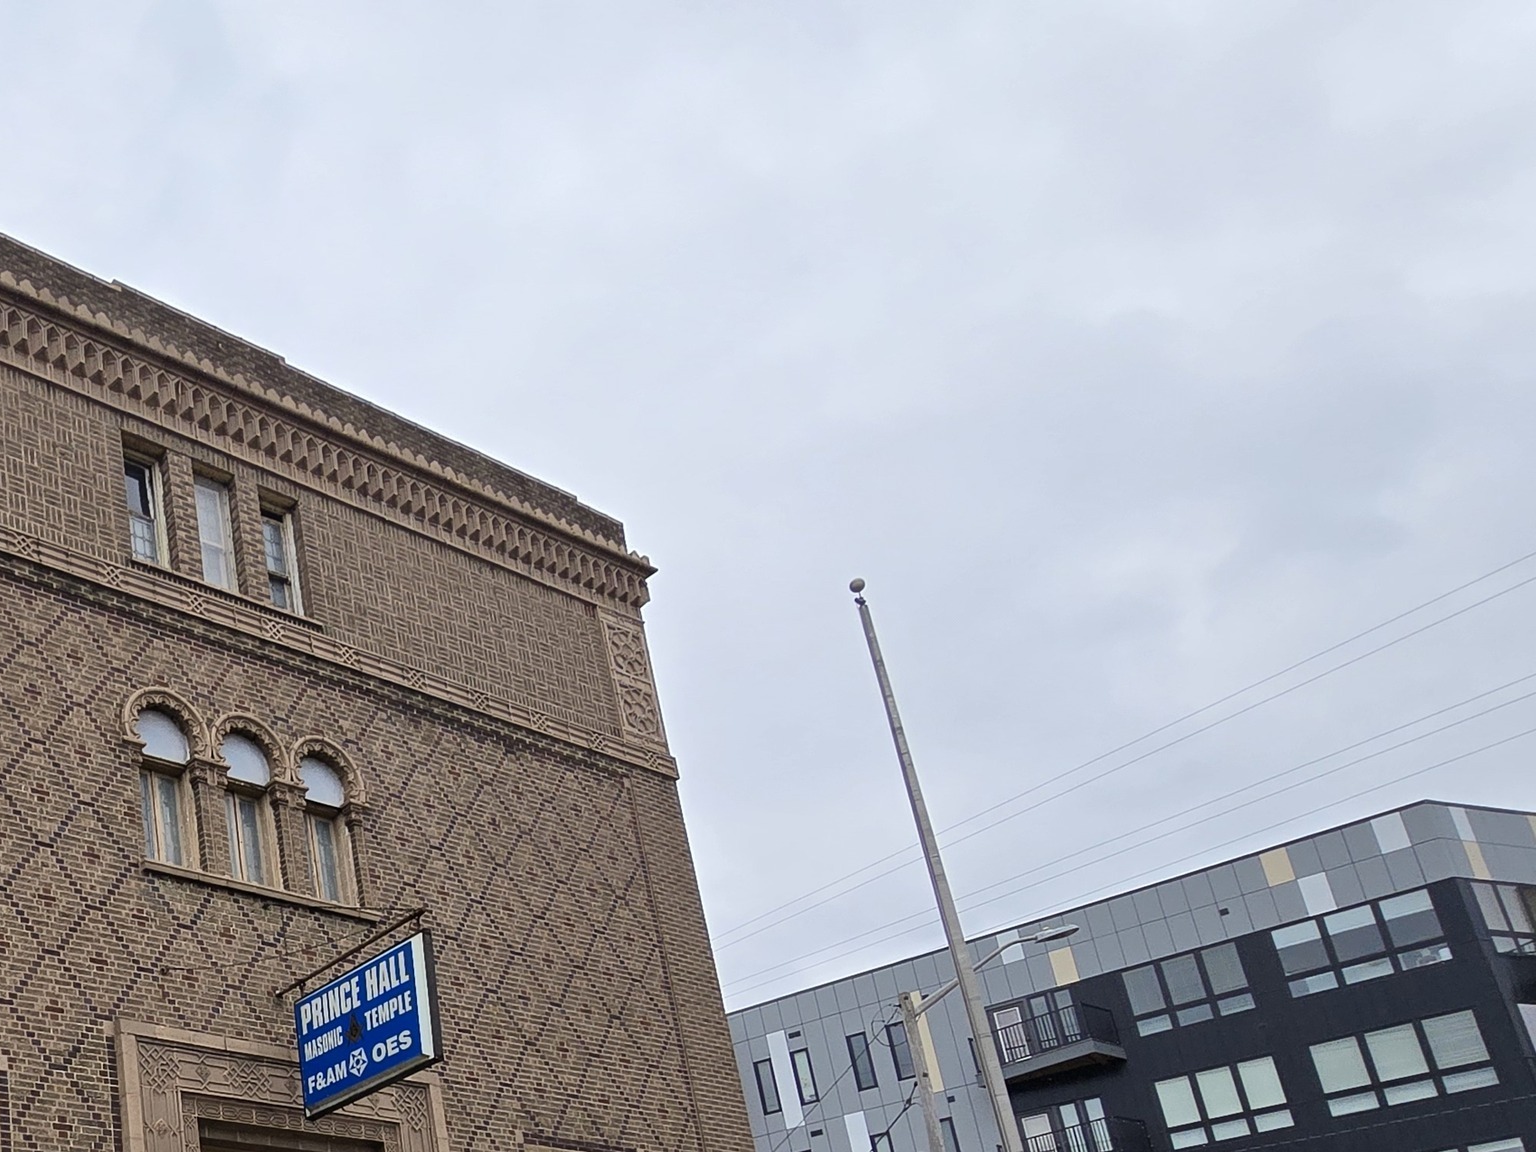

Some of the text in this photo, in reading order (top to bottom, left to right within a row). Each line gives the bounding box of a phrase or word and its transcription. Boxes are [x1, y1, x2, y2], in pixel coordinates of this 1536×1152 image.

[300, 950, 410, 1035] PRINCE HALL
[304, 990, 412, 1062] MASONIC TEMPLE
[307, 1030, 412, 1094] F&AM OES
